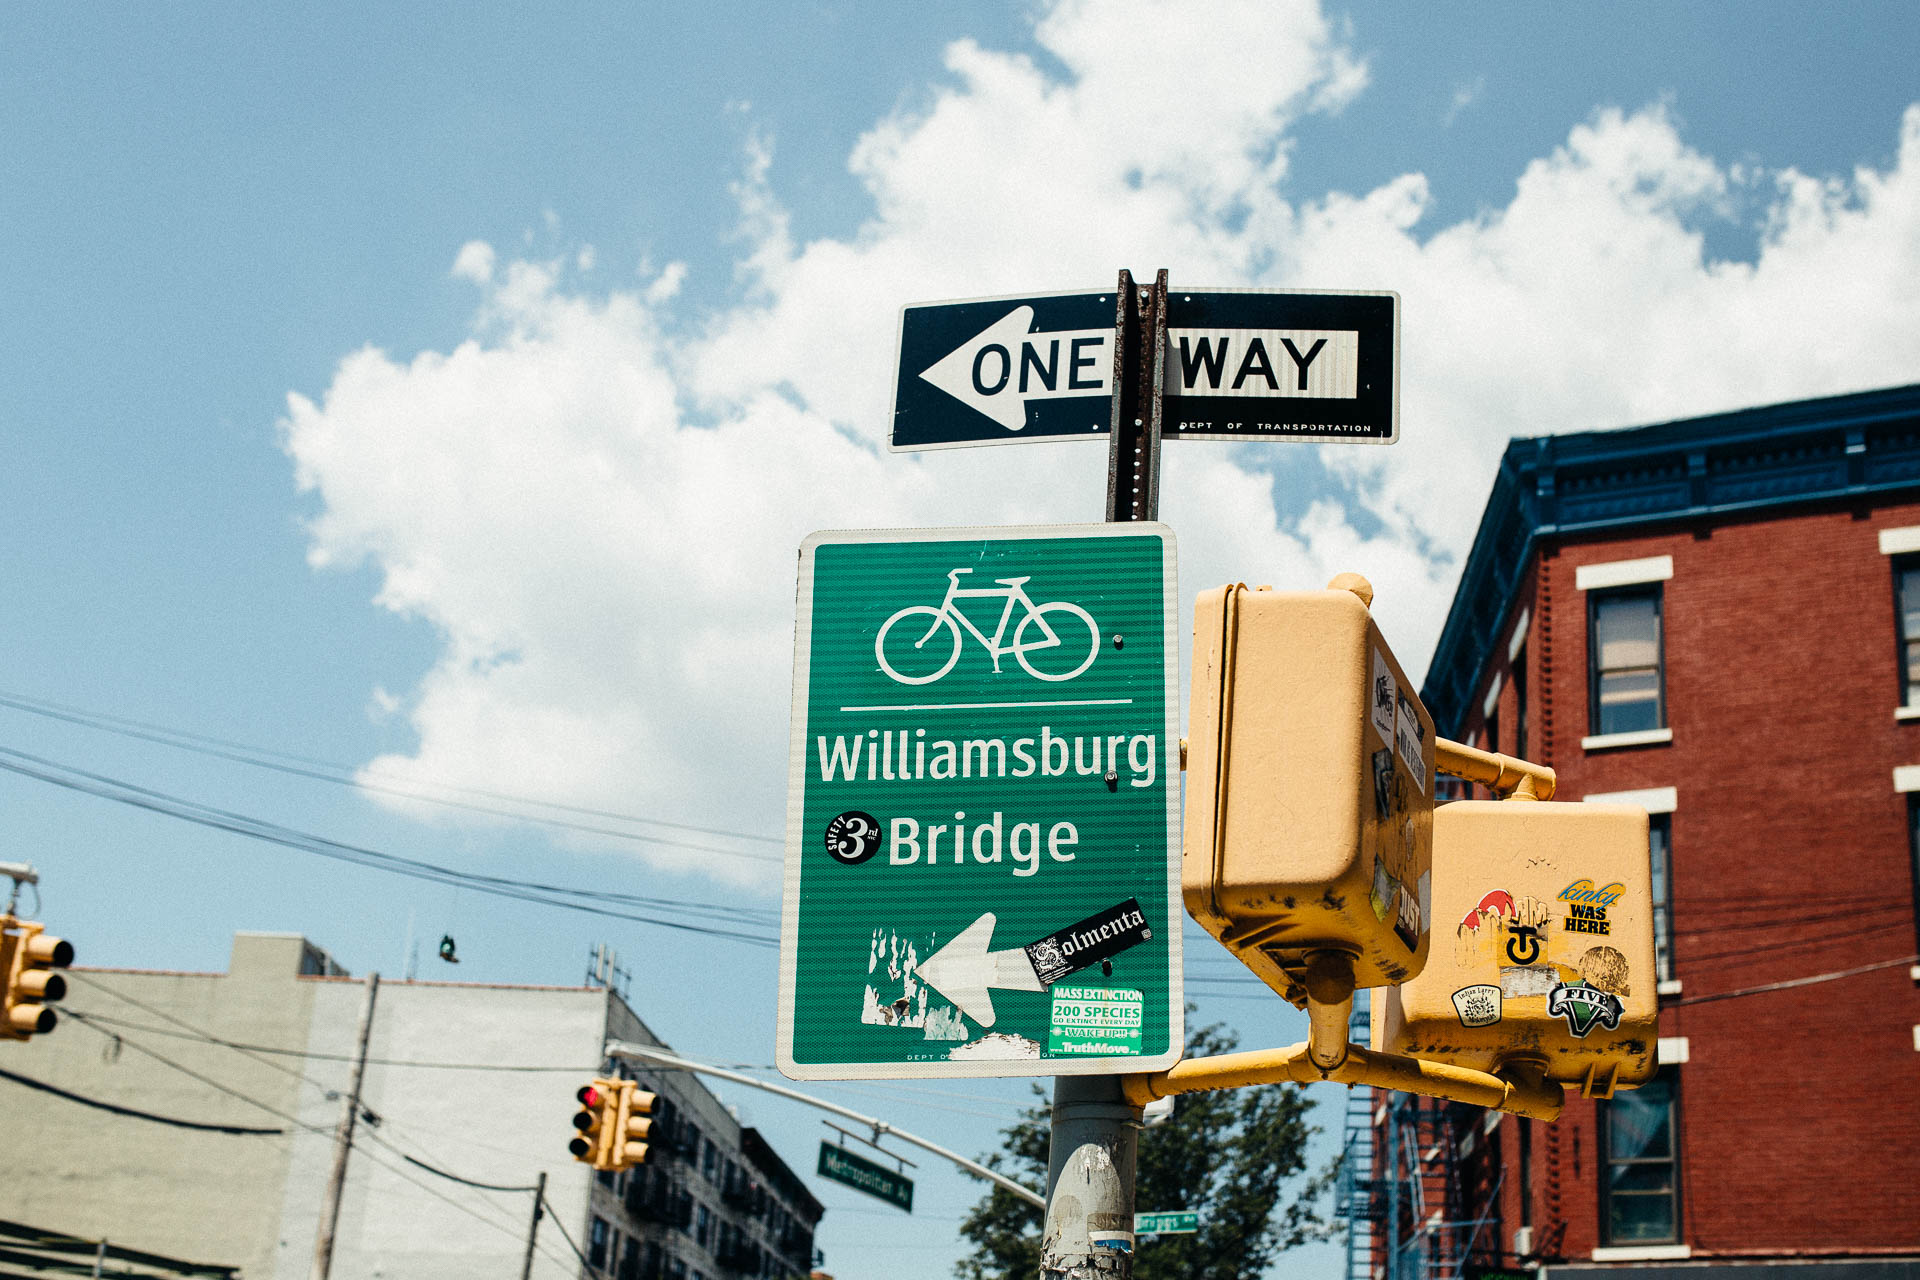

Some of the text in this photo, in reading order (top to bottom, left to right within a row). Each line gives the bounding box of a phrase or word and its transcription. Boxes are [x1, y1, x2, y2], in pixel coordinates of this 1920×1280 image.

[971, 336, 1328, 396] ONE WAY
[1181, 422, 1371, 432] DEPT OF TRANSPORTATION
[817, 726, 1156, 787] Williamsburg
[827, 815, 846, 850] SAFETY
[889, 811, 1079, 877] Bridge
[1558, 879, 1624, 912] kinky
[1570, 904, 1607, 920] WAS
[1564, 918, 1610, 935] HERE
[1054, 987, 1143, 1001] MASS EXTINCTION
[1054, 1005, 1140, 1018] 200 SPECIES
[1066, 1028, 1102, 1038] WAKE
